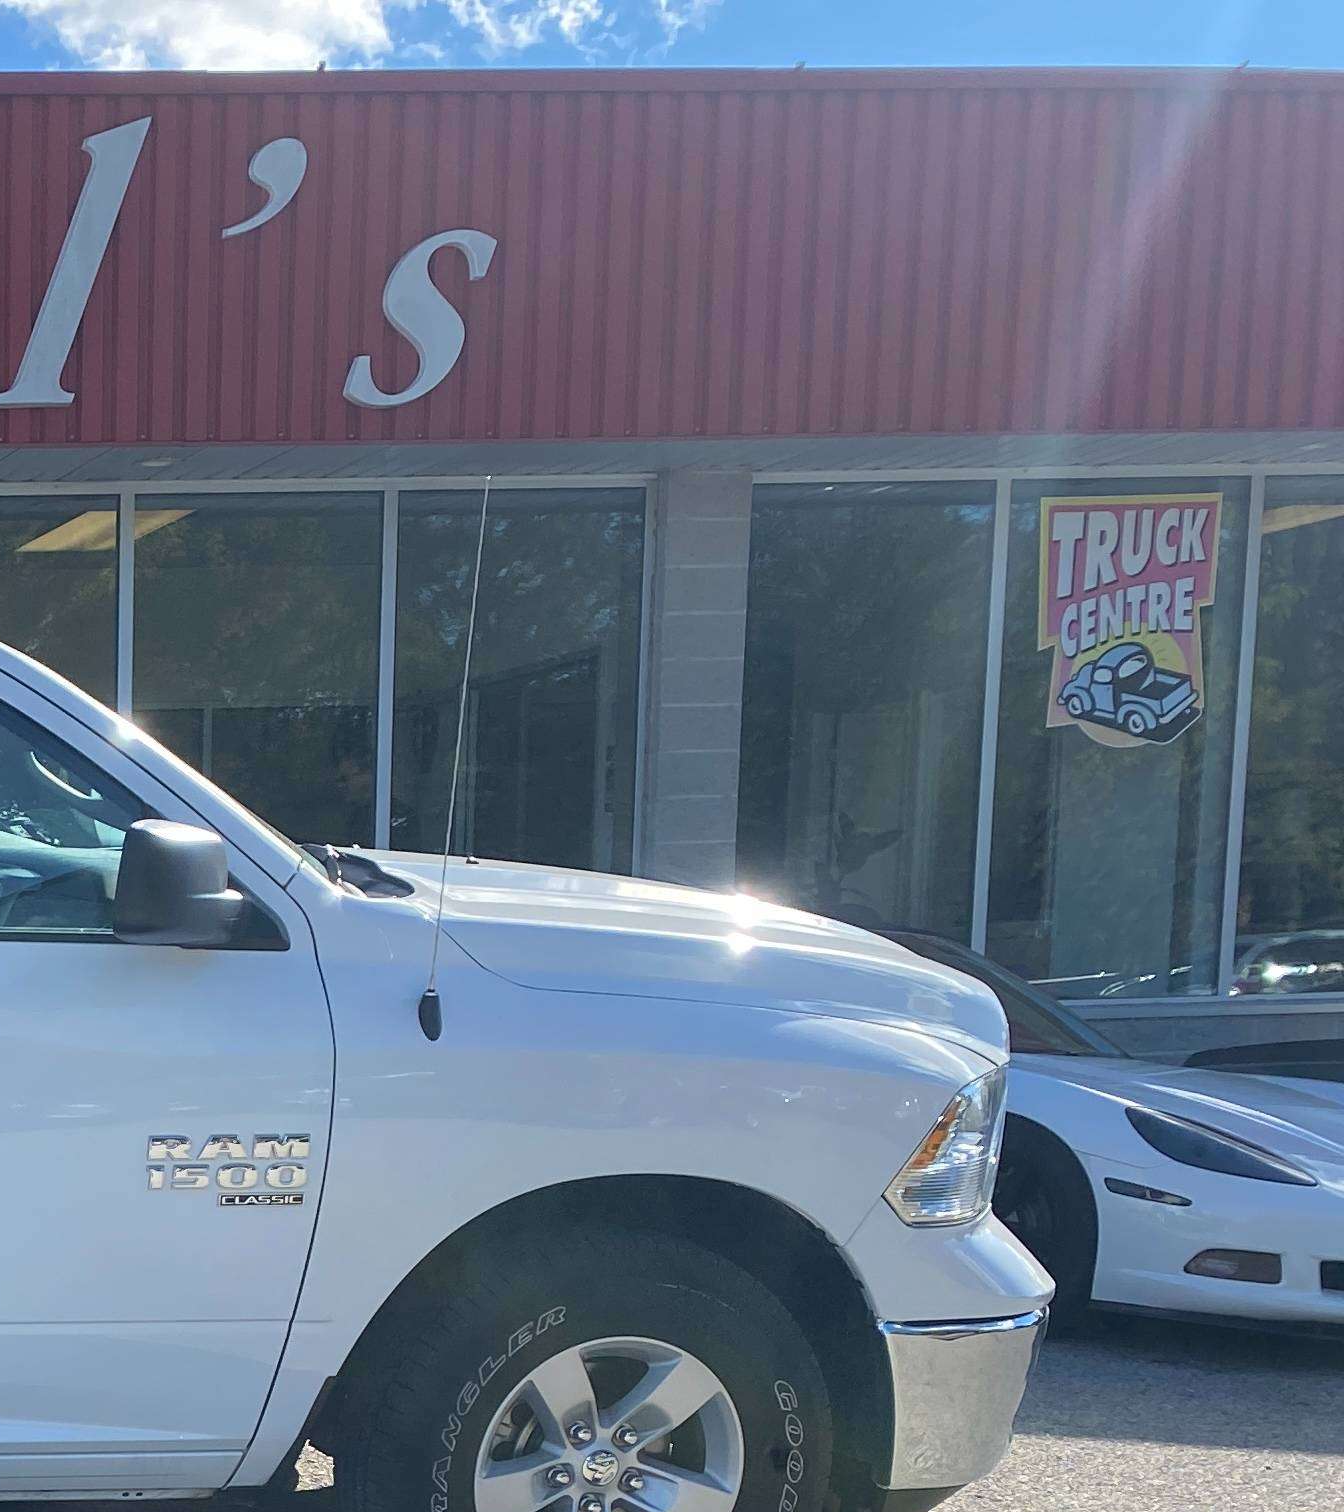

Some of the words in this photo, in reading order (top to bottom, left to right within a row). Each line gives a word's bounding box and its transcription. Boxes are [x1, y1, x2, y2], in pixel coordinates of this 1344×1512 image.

[1052, 508, 1209, 600] TRUCK
[1061, 577, 1195, 658] CENTRE
[147, 1133, 311, 1161] RAM
[146, 1163, 308, 1192] 1500
[220, 1194, 303, 1206] CLASSIC
